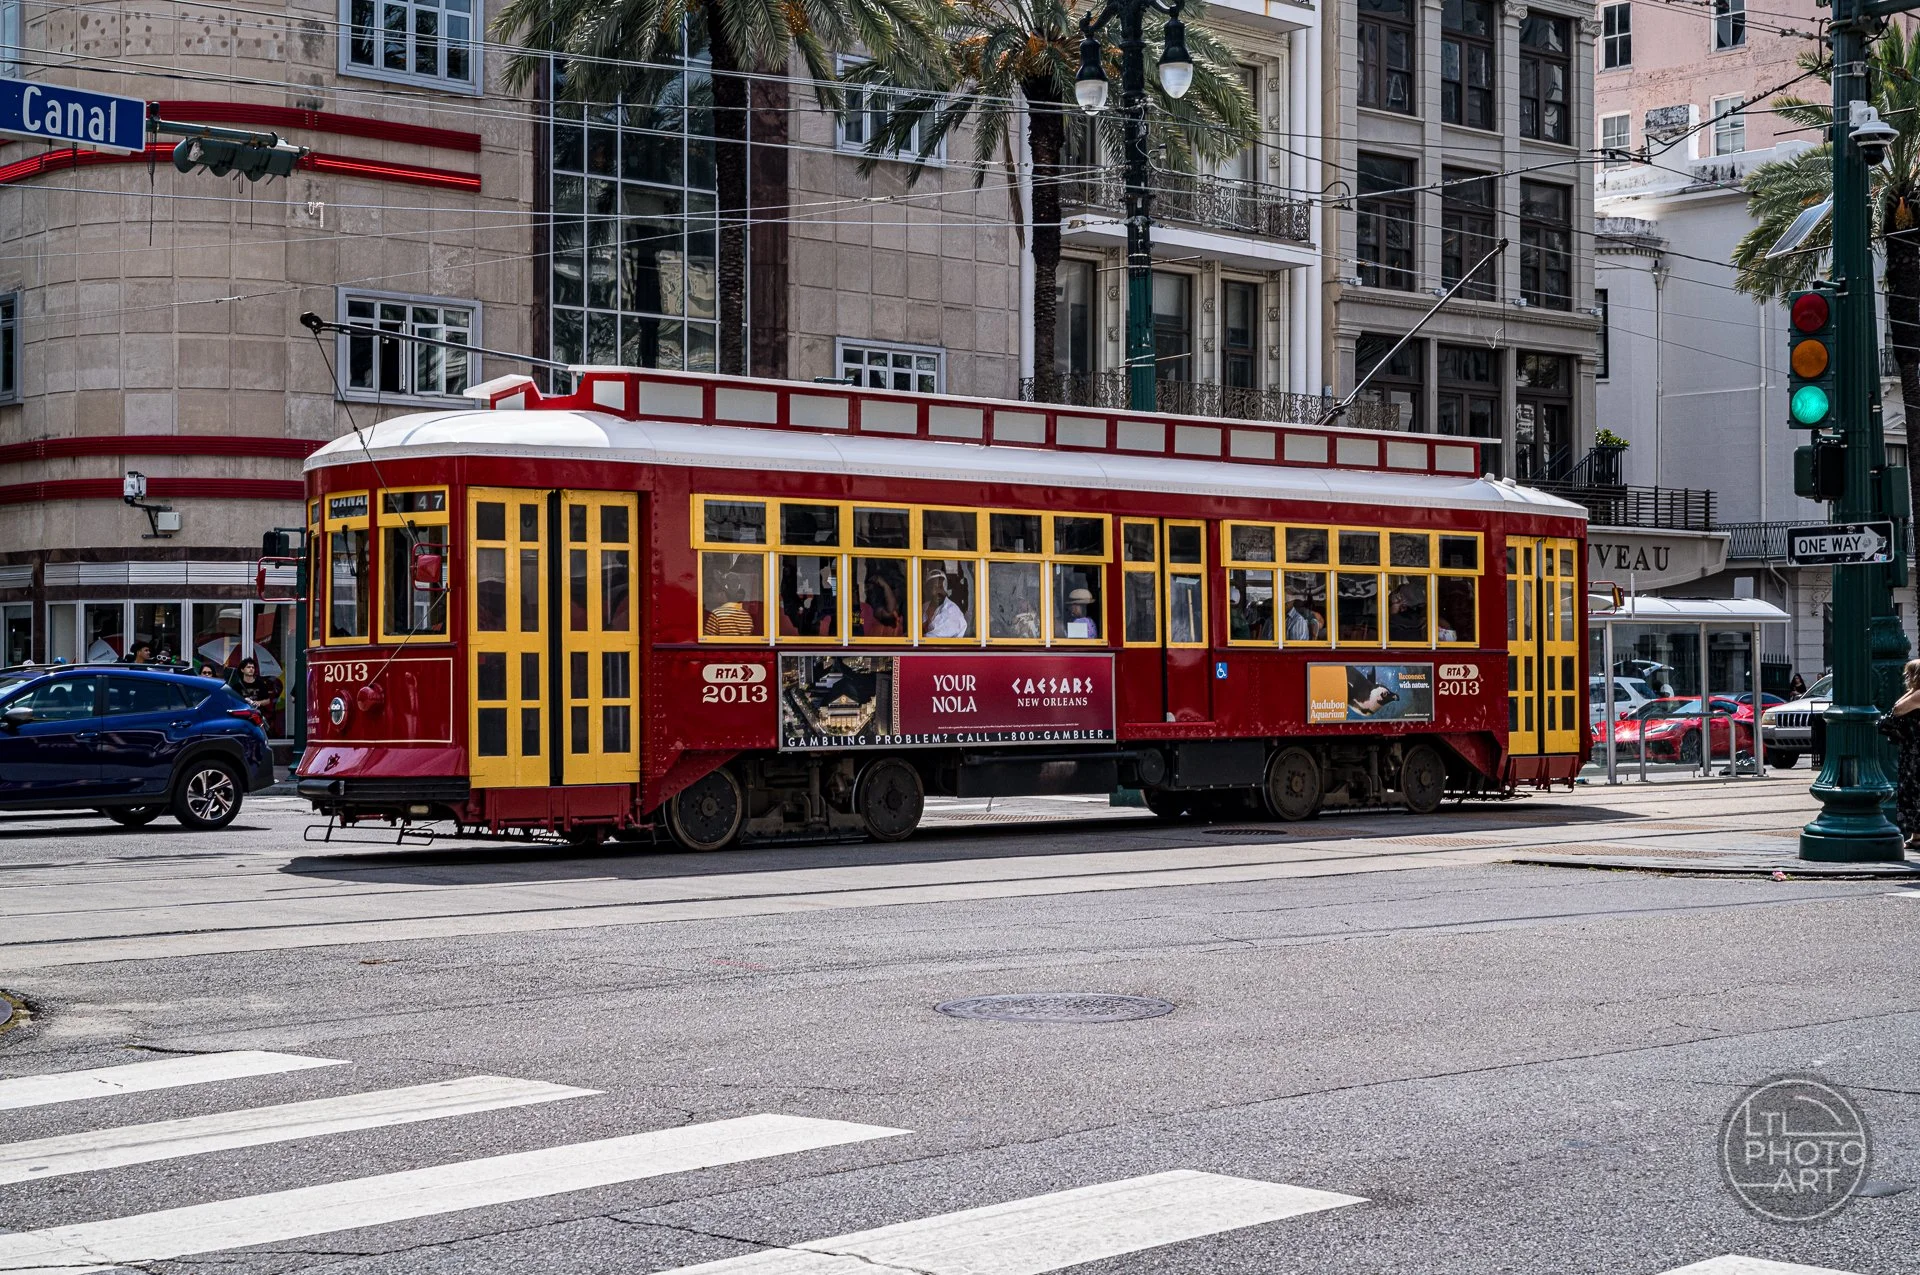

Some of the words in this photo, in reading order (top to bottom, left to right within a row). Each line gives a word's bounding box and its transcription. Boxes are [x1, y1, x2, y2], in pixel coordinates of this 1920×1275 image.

[22, 85, 117, 143] Canal
[1798, 538, 1827, 554] ONE
[1832, 536, 1862, 552] WAY
[324, 662, 368, 683] 2013
[715, 668, 738, 679] RTA
[1398, 672, 1426, 680] Reconnect
[1446, 667, 1461, 676] RTA
[932, 673, 977, 692] YOUR
[1011, 677, 1093, 694] CAESARS
[1399, 681, 1411, 689] with
[1438, 681, 1480, 696] 2013
[702, 685, 768, 703] 2013
[1017, 698, 1039, 707] NEW
[1042, 697, 1088, 707] ORLEANS
[932, 695, 978, 714] NOLA
[1310, 699, 1345, 710] Audubon
[1310, 709, 1345, 720] Aquarium
[788, 735, 866, 747] GAMBLING
[875, 733, 948, 745] PROBLEM?
[957, 733, 989, 743] CALL
[997, 729, 1109, 742] 1-800-GAMBLER.
